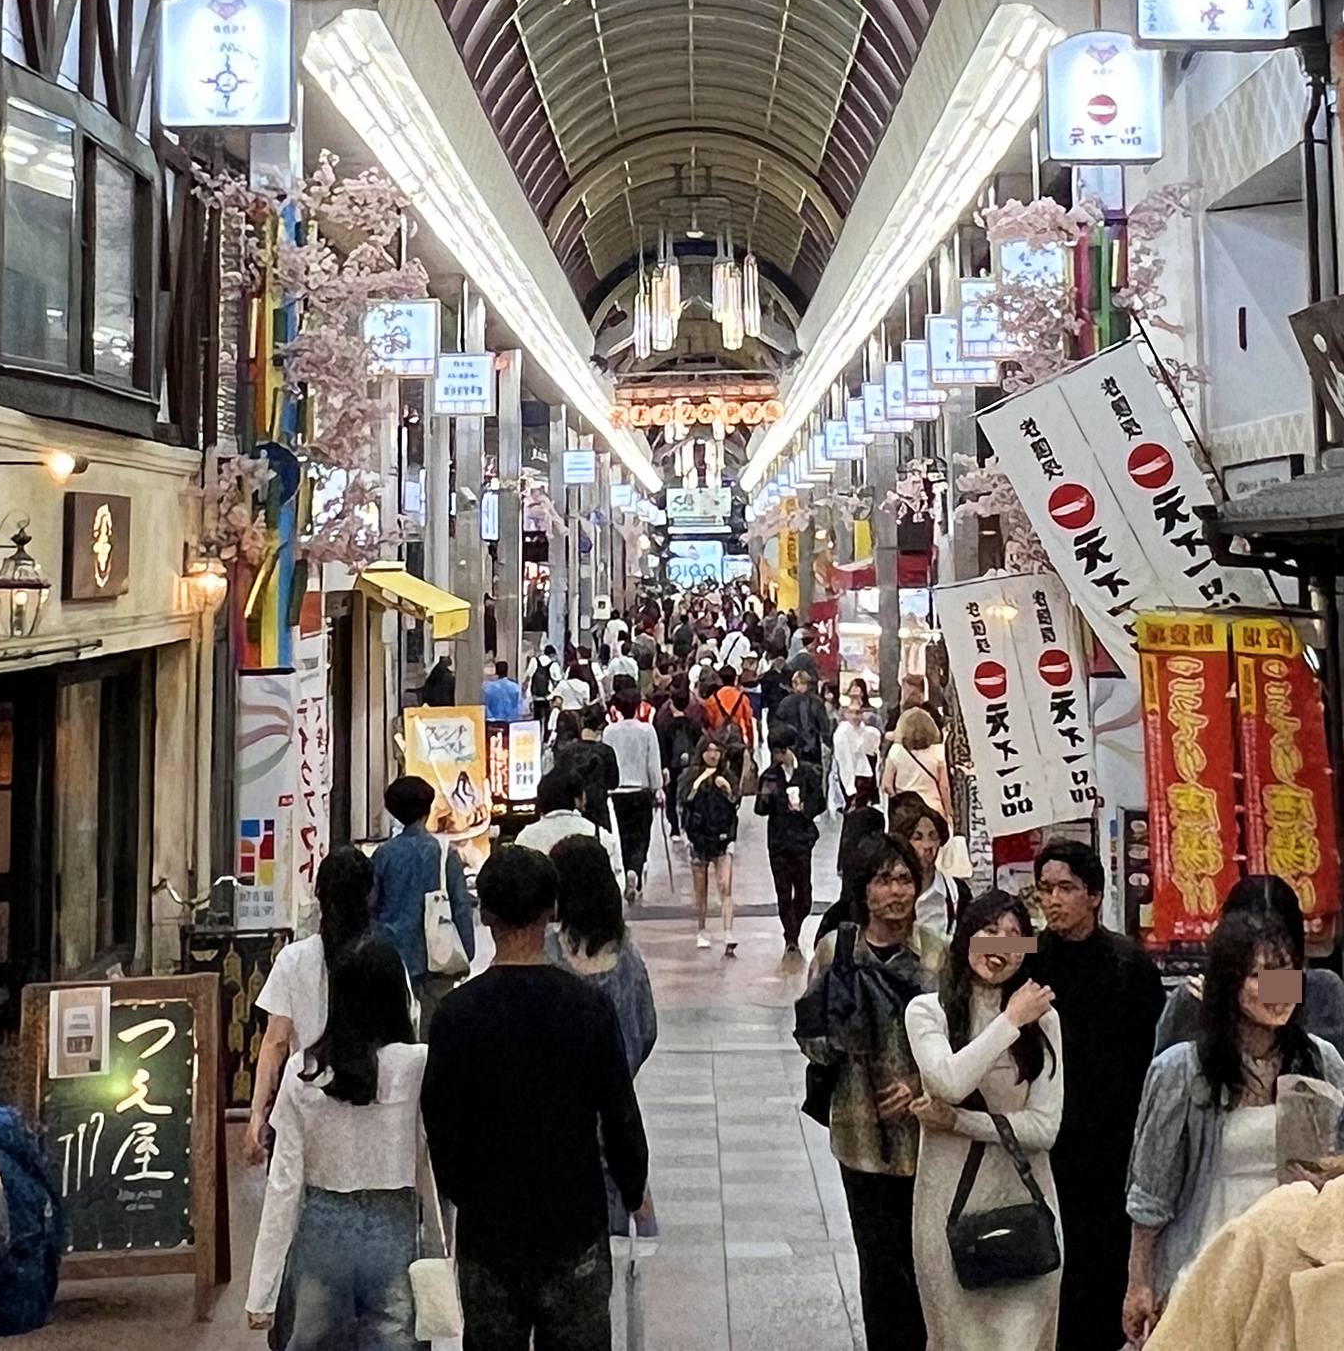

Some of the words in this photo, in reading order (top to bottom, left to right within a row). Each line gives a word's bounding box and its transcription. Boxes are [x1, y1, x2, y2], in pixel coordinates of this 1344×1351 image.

[985, 701, 1035, 819] 天下一品
[1049, 689, 1099, 804] 天下一品
[111, 1018, 176, 1181] つえ屋
